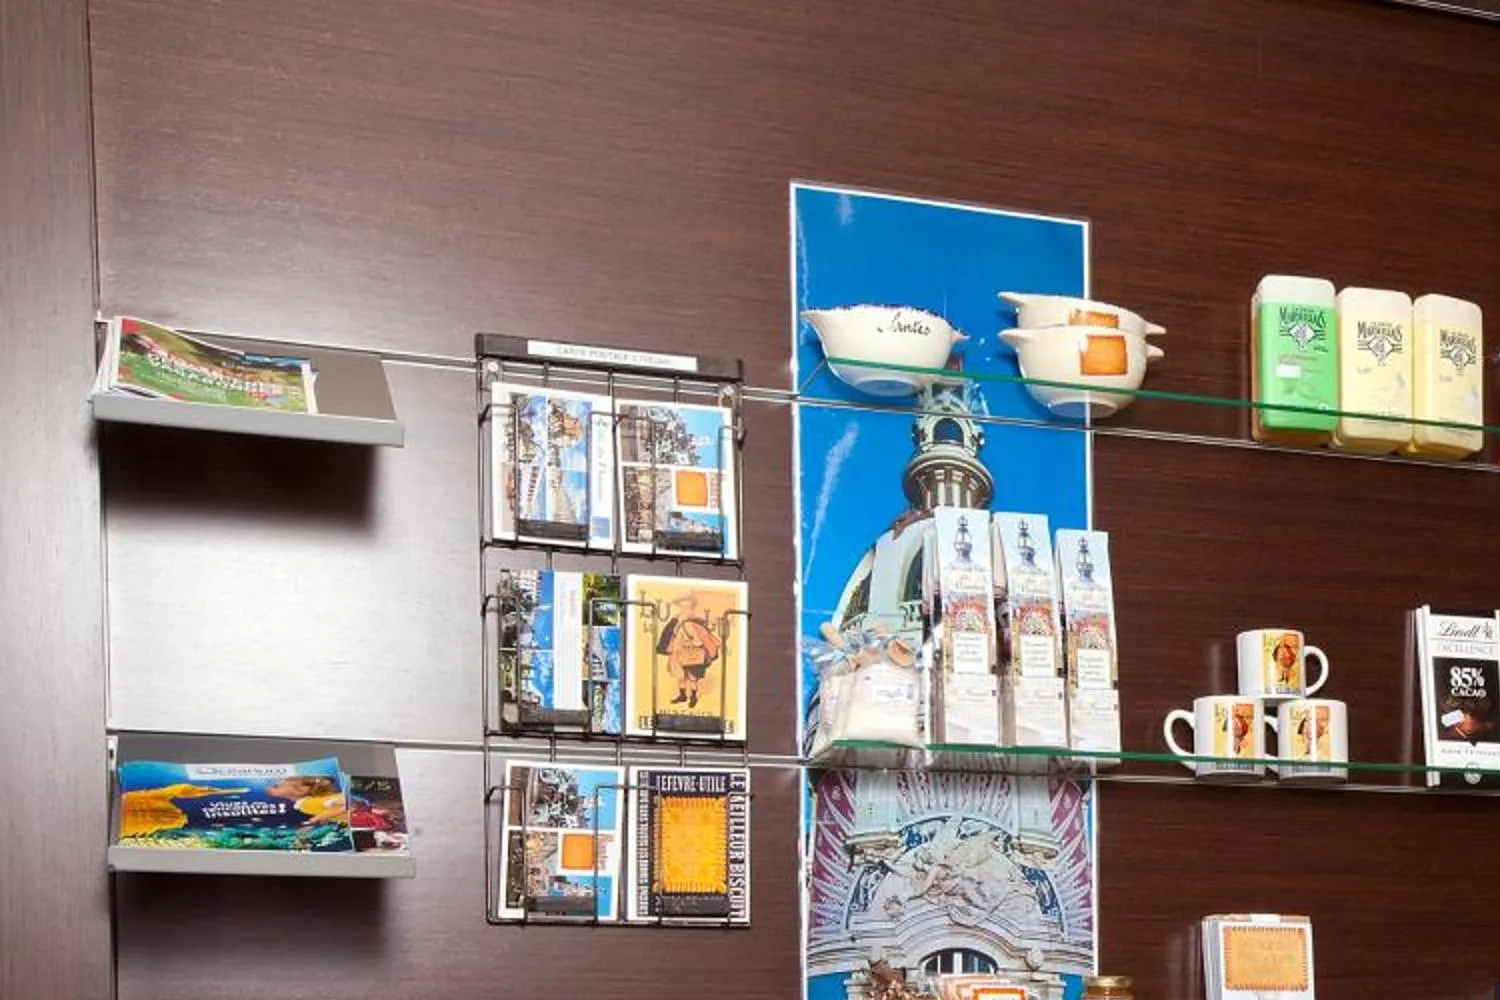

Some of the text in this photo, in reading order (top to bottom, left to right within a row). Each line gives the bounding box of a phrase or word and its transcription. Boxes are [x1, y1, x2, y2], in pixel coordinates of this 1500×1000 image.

[1440, 621, 1480, 638] Lindt
[1450, 665, 1485, 688] 85%
[1451, 687, 1486, 698] CACAO
[730, 866, 746, 919] BISCUIT
